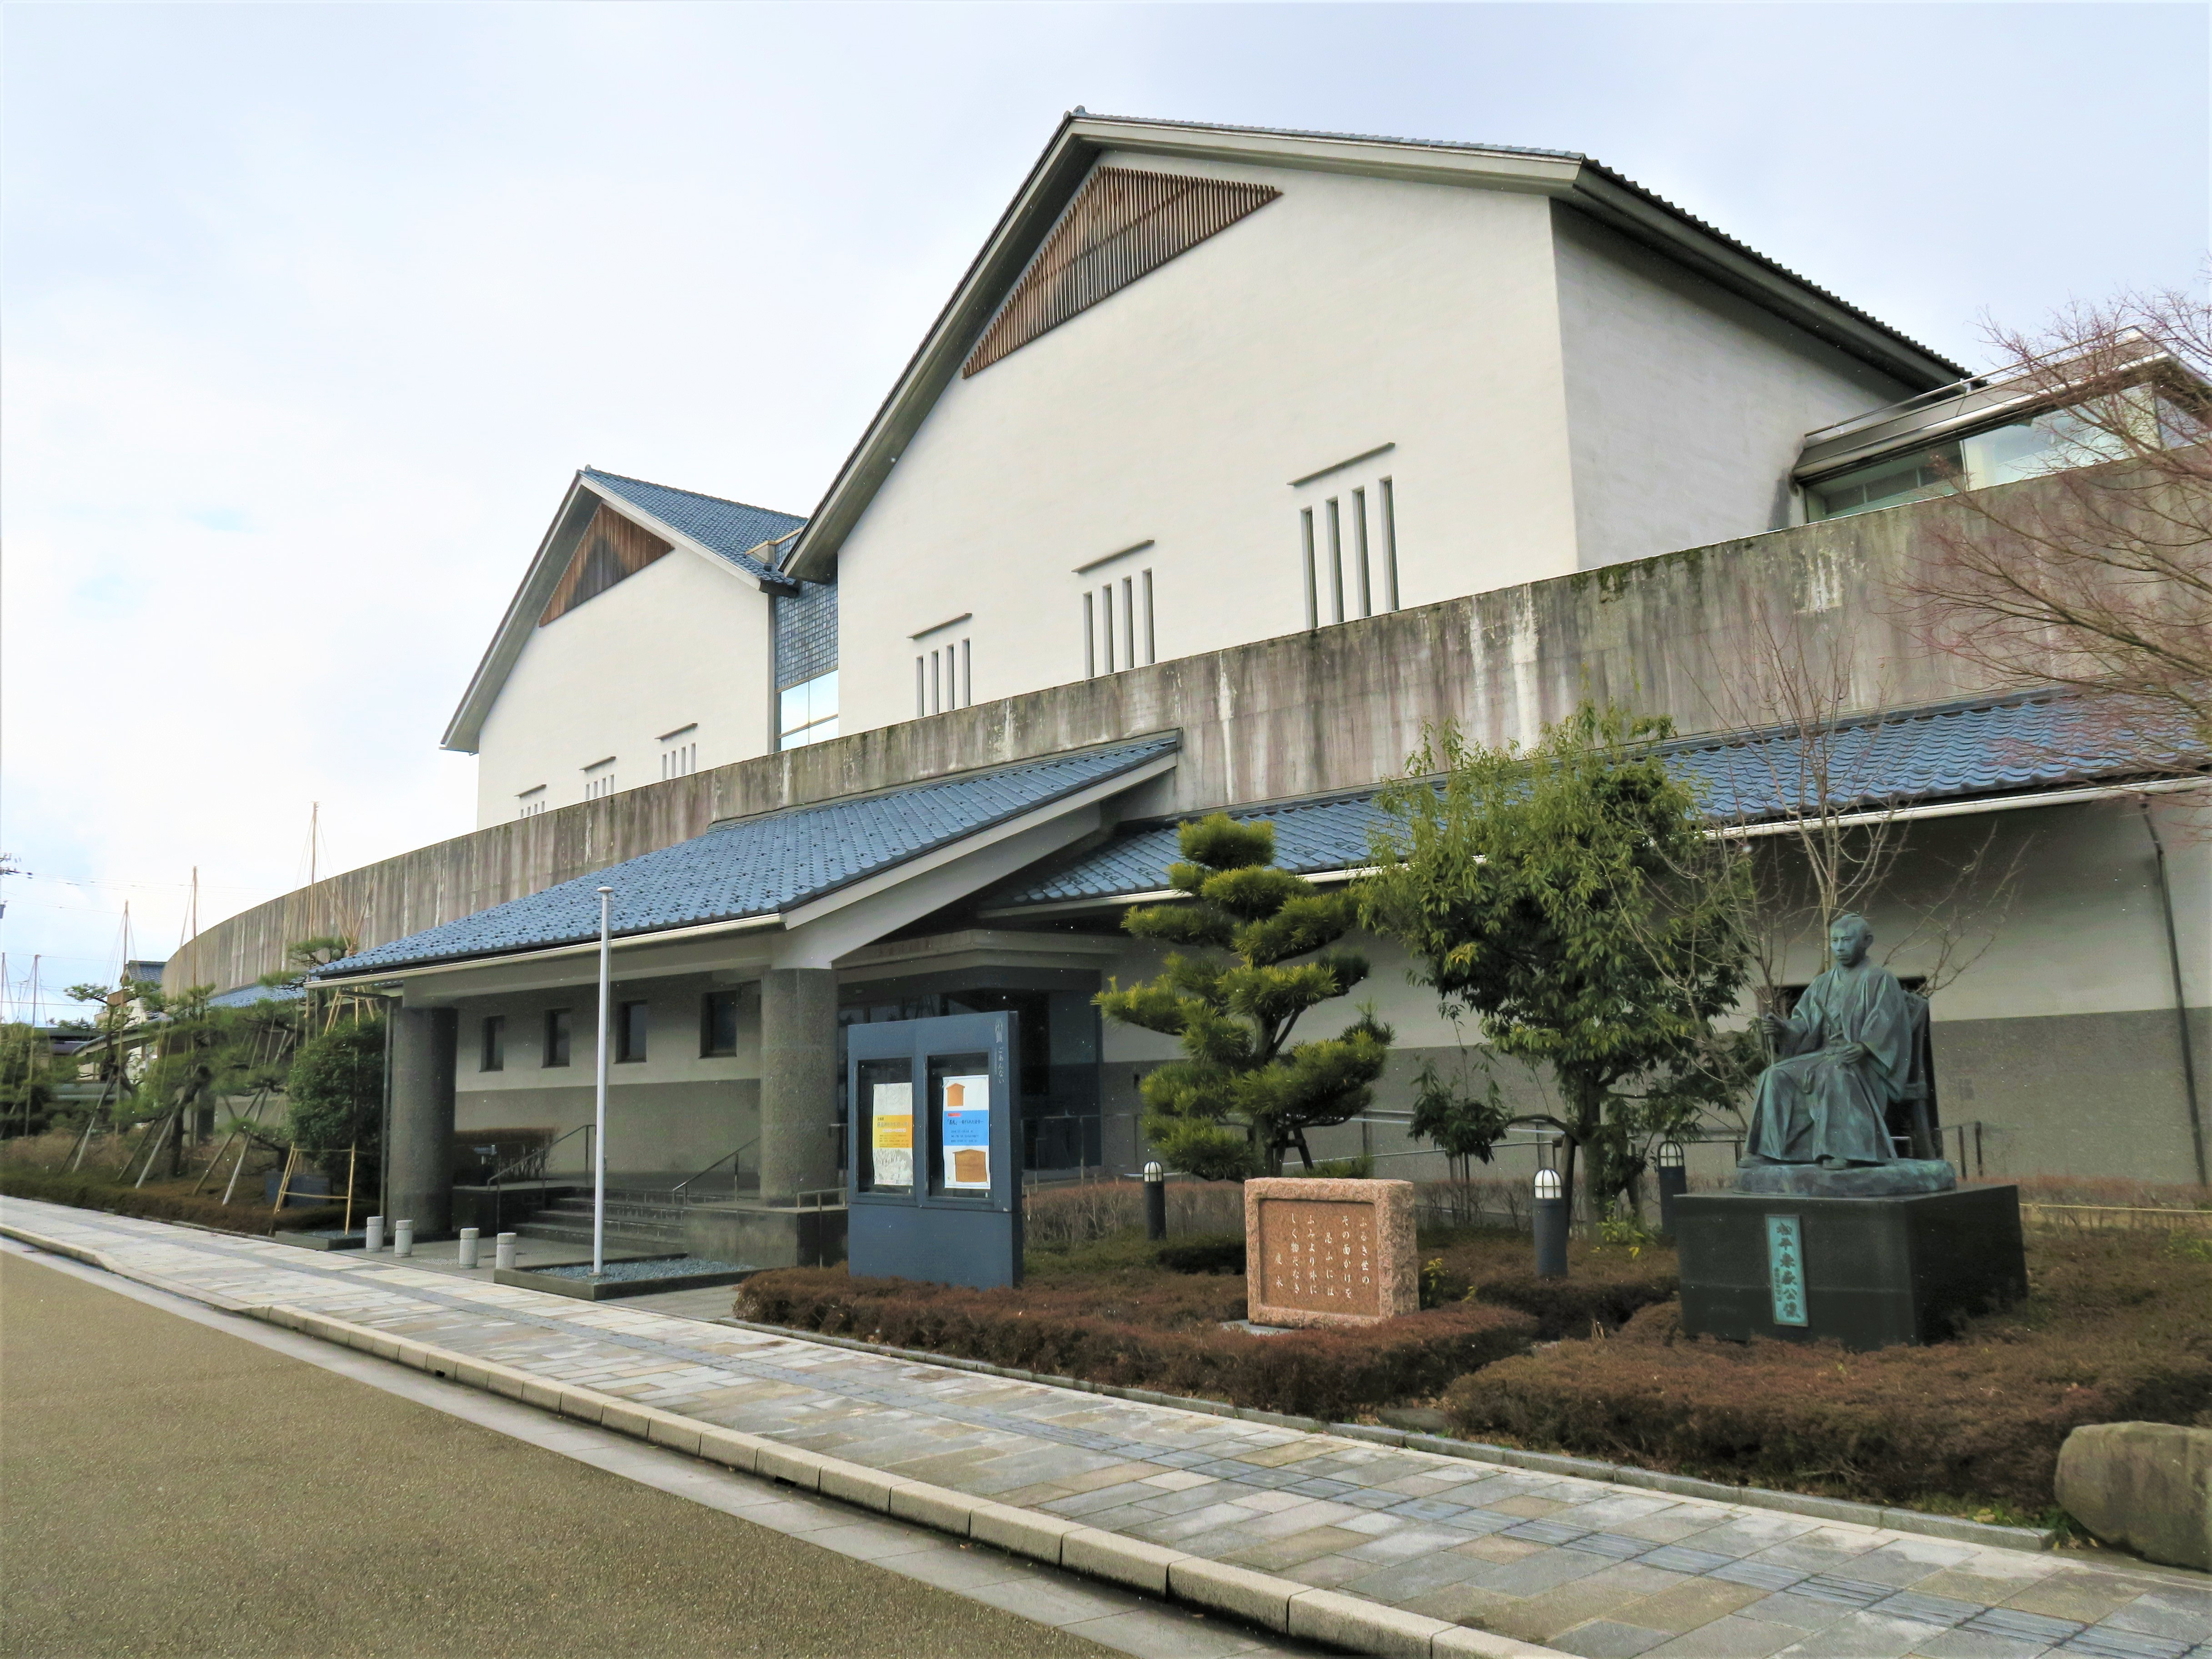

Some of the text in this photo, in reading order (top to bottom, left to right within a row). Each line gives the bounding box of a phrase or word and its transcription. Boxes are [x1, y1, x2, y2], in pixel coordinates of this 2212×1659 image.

[1360, 1217, 1370, 1285] ふるき世の
